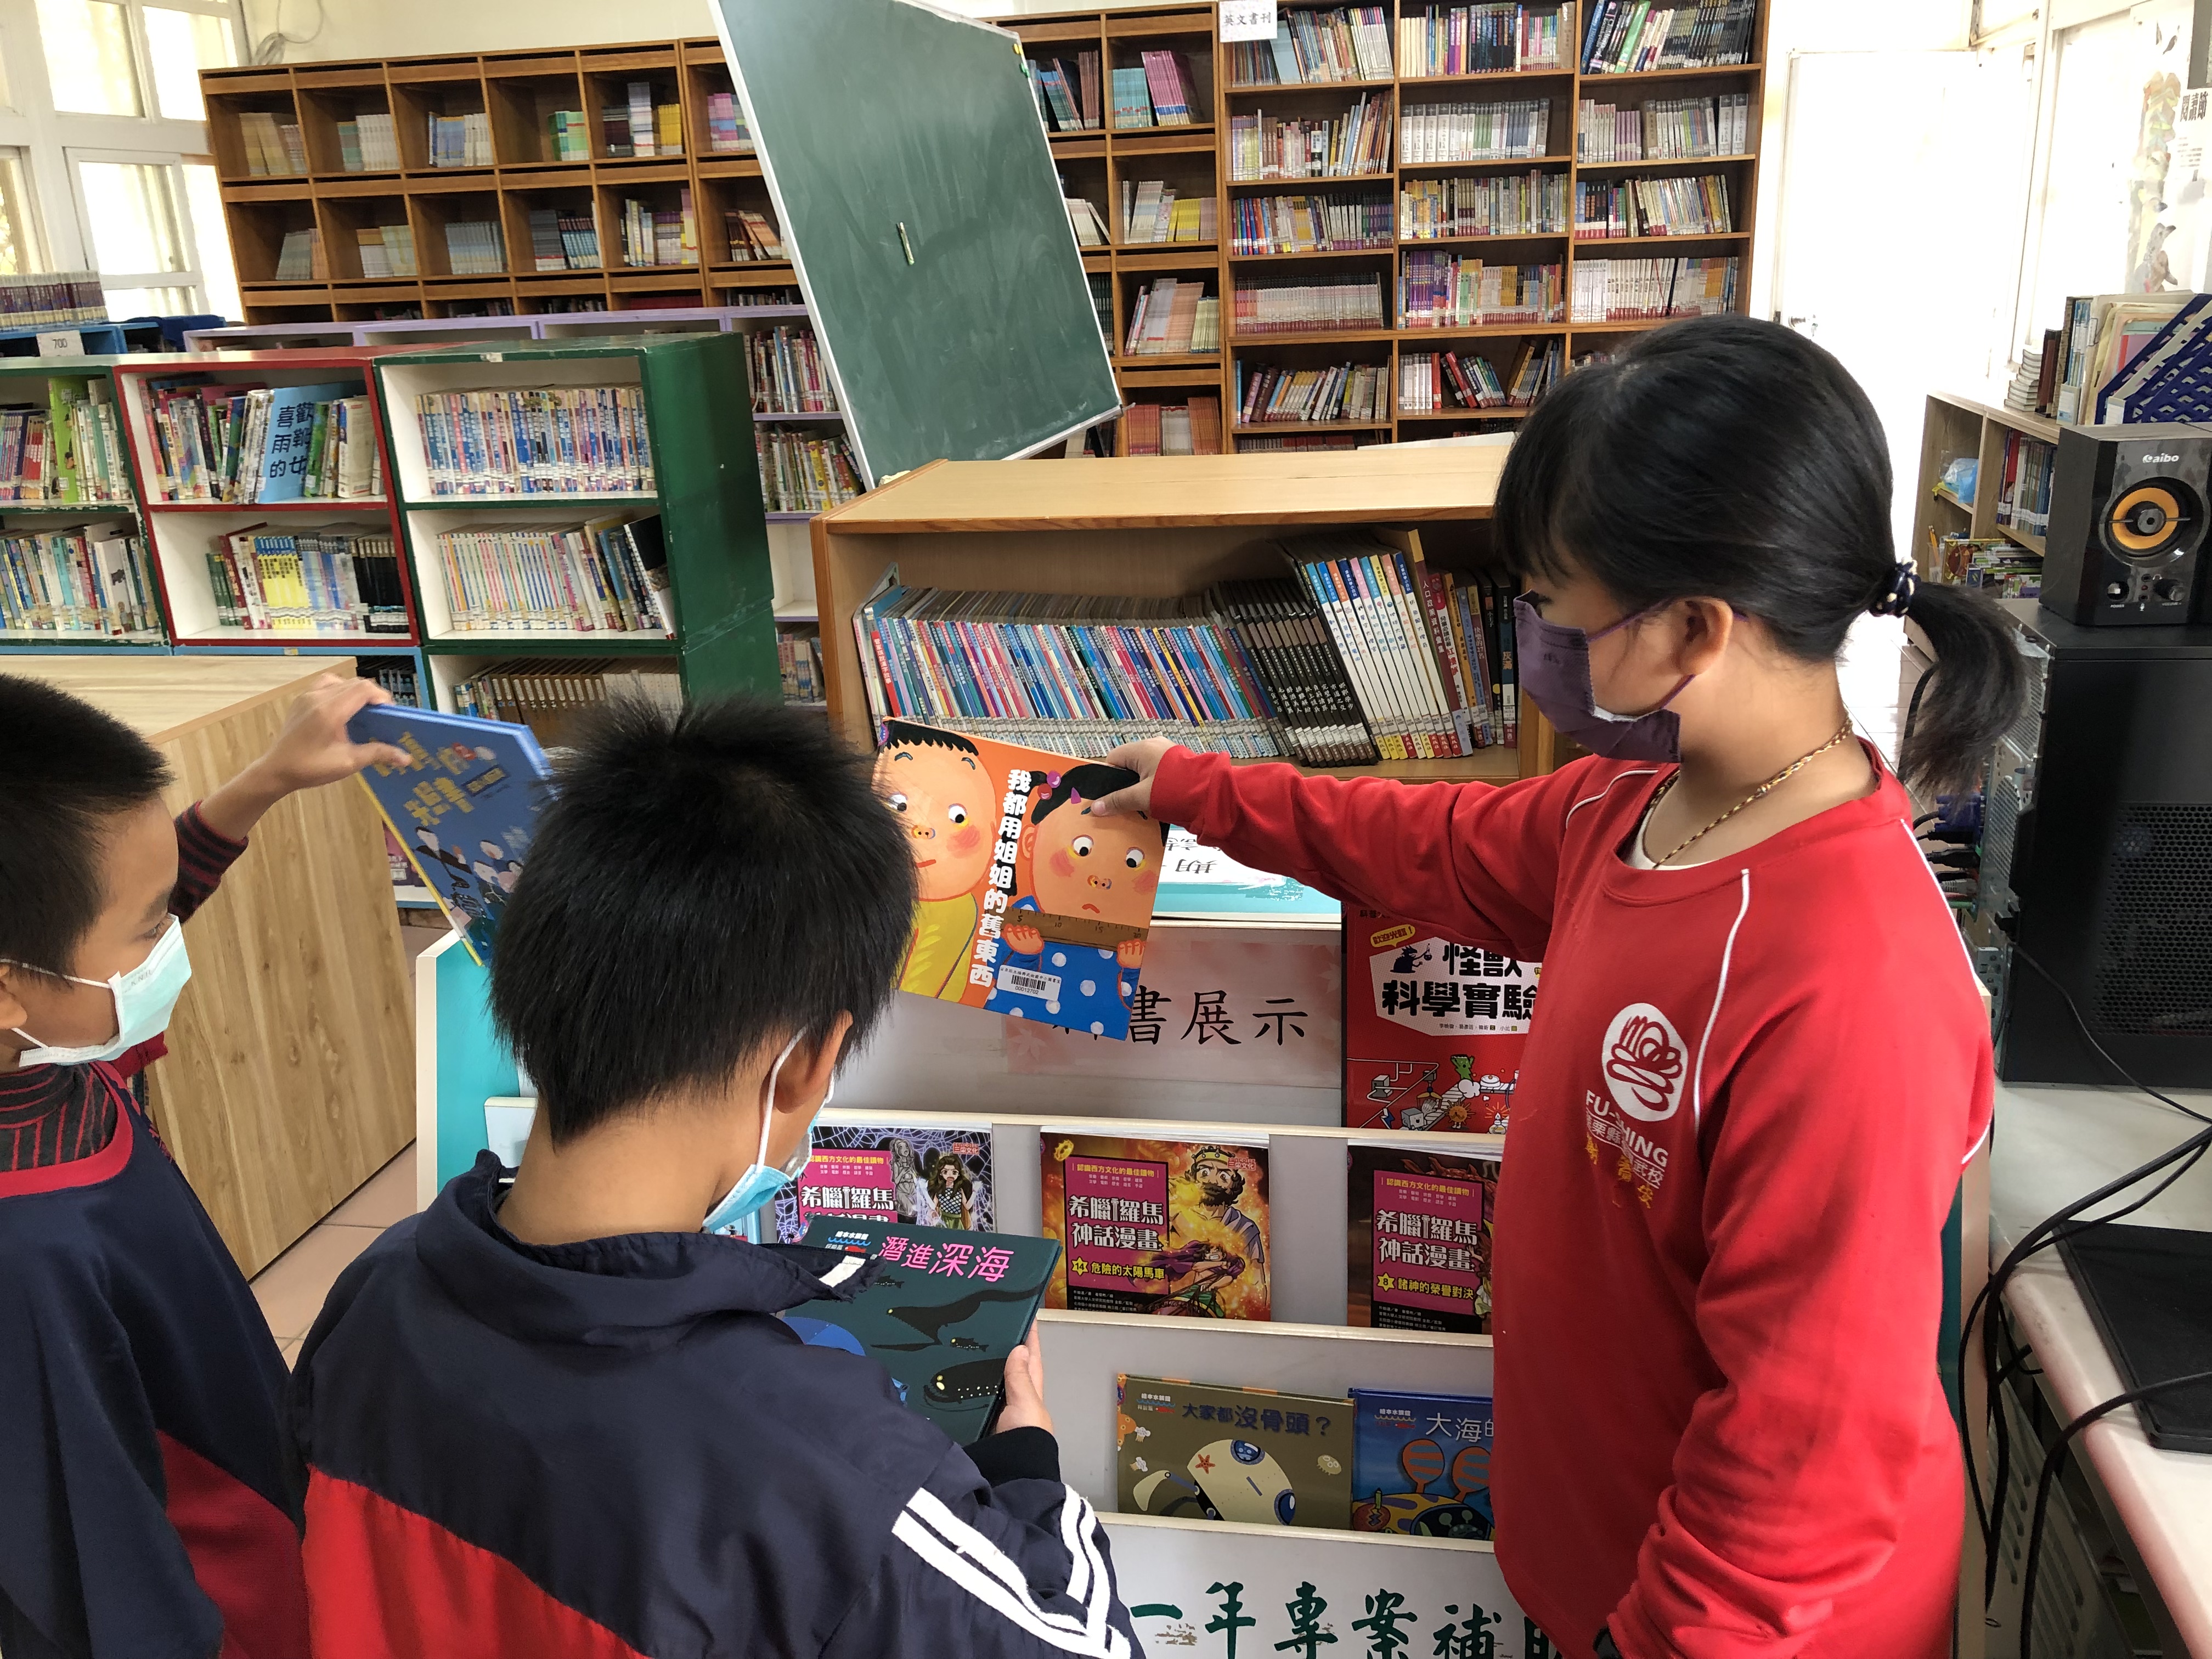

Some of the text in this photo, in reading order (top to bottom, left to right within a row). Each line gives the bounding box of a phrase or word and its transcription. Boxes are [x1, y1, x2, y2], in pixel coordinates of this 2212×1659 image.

[1223, 12, 1271, 26] 英文書刊
[2180, 91, 2208, 122] 閱讀節
[52, 338, 67, 349] 700
[2152, 453, 2179, 463] aibo
[969, 769, 1032, 988] 我都用姐姐的舊東西
[1095, 925, 1104, 933] 15
[1442, 942, 1522, 977] 怪獸
[1015, 986, 1039, 995] 00012702
[1382, 979, 1537, 1020] 科學實驗
[1077, 1164, 1154, 1177] 認識西方文化的最佳讀物
[1387, 1178, 1469, 1196] 認識西方文化的最佳讀物
[1071, 1222, 1163, 1251] 神話漫畫
[878, 1235, 1014, 1282] 潛進深海
[1379, 1238, 1474, 1272] 神話漫畫
[1075, 1262, 1164, 1279] 14 危險的太陽馬車
[1398, 1278, 1474, 1300] 諸神的榮譽對決
[1181, 1402, 1332, 1437] 大家都沒骨頭？
